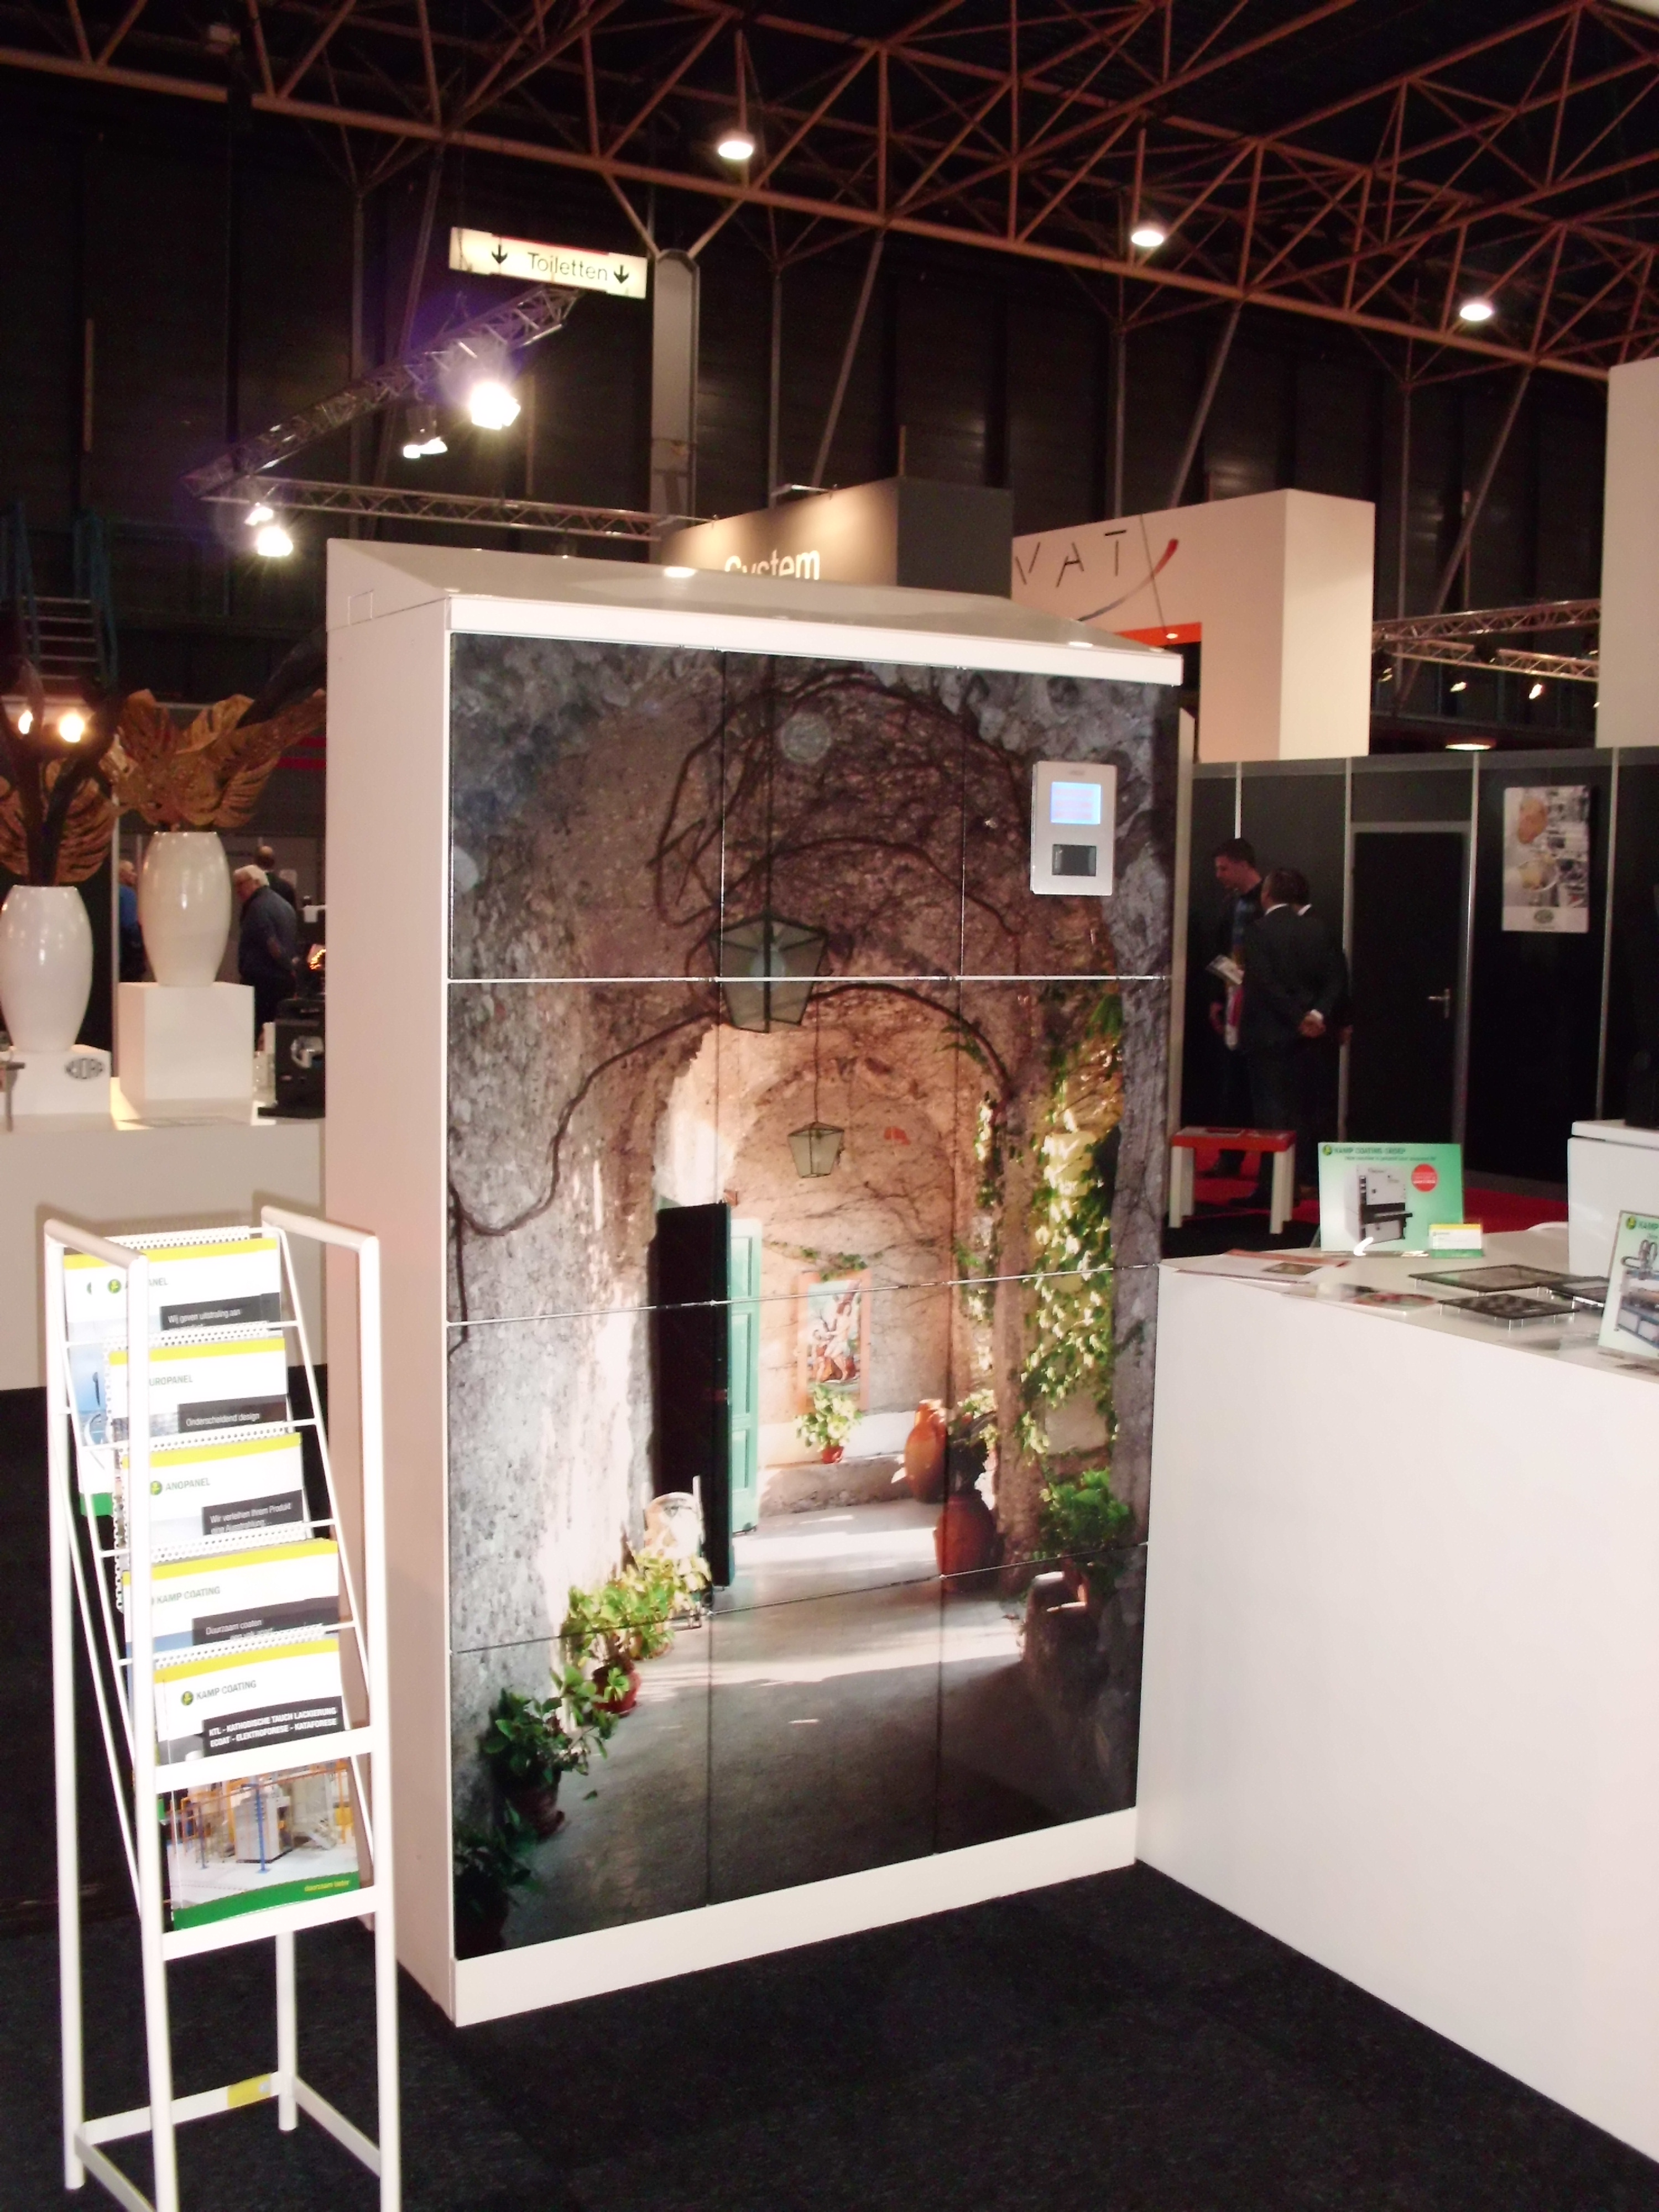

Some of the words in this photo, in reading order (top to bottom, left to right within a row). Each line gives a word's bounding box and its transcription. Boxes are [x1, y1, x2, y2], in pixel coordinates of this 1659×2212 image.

[527, 252, 608, 281] Toiletten
[149, 1374, 194, 1386] UROPANEL
[186, 1414, 237, 1427] Onderscheidend
[238, 1413, 260, 1422] design
[165, 1477, 211, 1491] ANOPANEL
[210, 1515, 221, 1524] Wir
[222, 1511, 250, 1521] verleihen
[269, 1502, 291, 1514] Produkt
[156, 1592, 182, 1604] KAMP
[184, 1586, 221, 1600] COATING
[205, 1624, 239, 1636] Duurzaam
[240, 1619, 262, 1630] coaten
[196, 1687, 220, 1700] KAMP
[221, 1680, 257, 1694] COATING
[208, 1727, 222, 1736] KTL
[227, 1717, 271, 1733] KATHODISCHE
[271, 1714, 293, 1724] TAUCH
[294, 1707, 337, 1720] LACKIERUNG
[210, 1736, 232, 1748] ECOAT
[236, 1724, 290, 1741] ELEKTROFORESE
[294, 1718, 337, 1730] KATAFORESE
